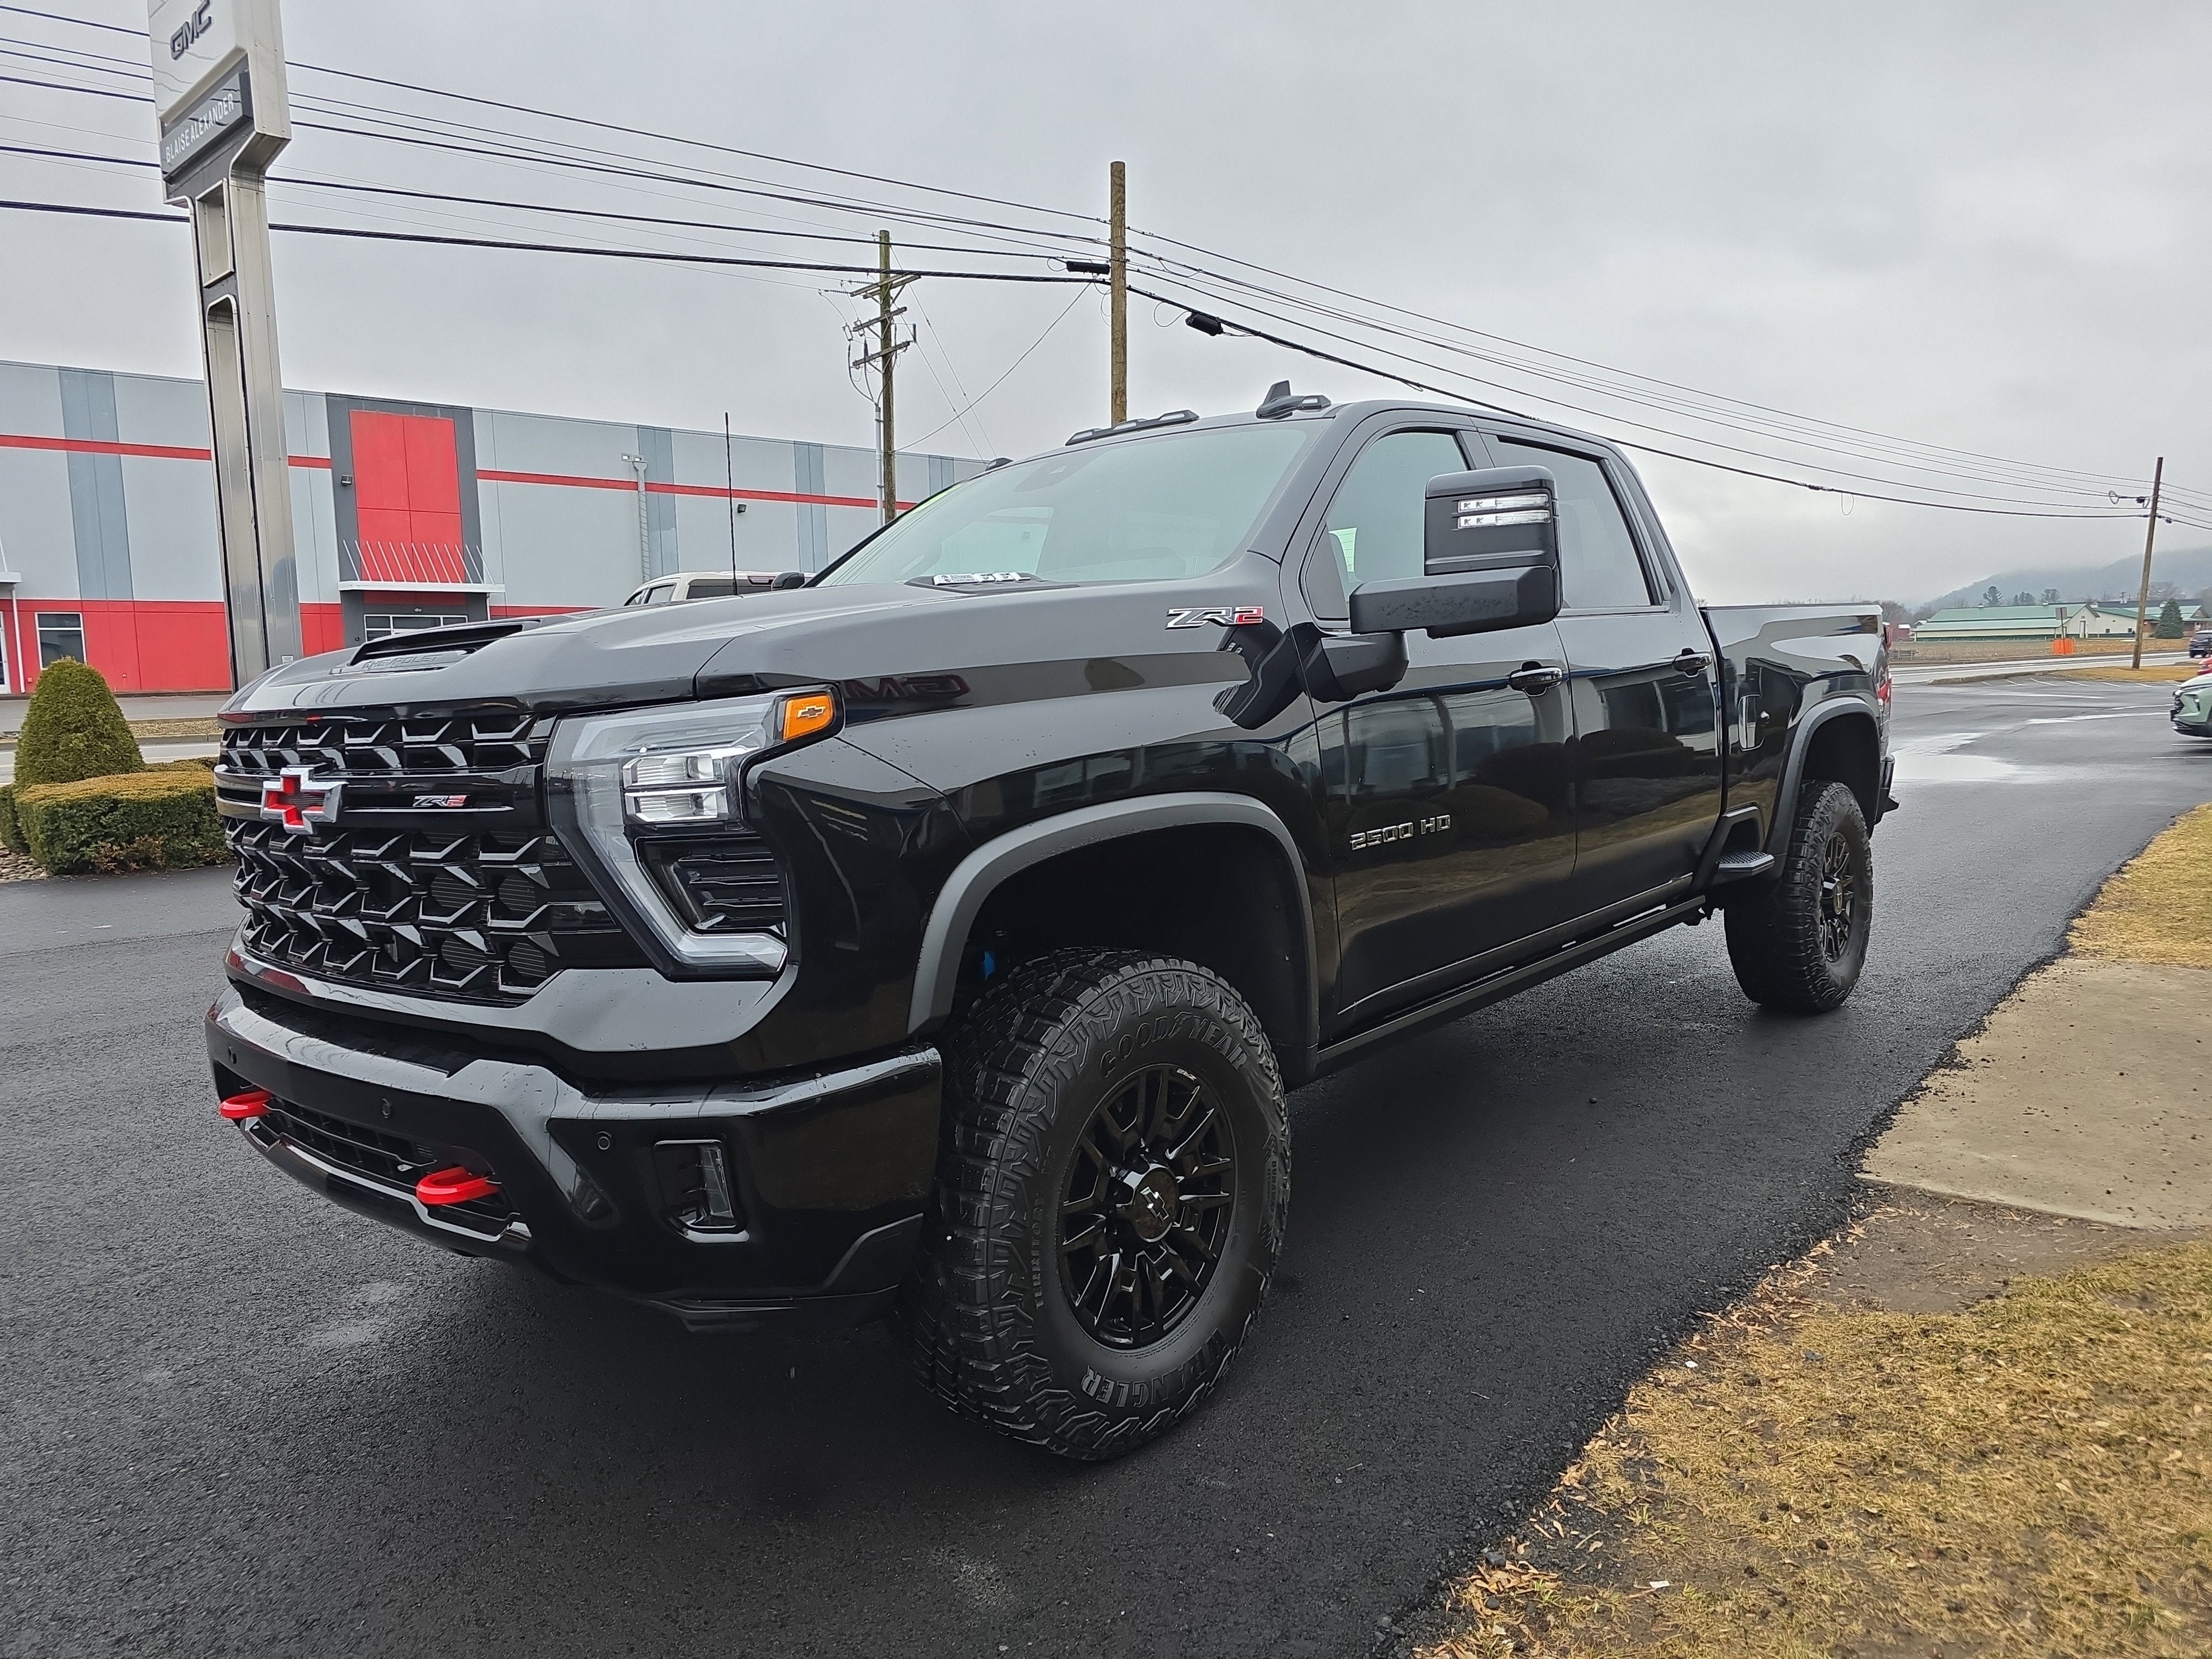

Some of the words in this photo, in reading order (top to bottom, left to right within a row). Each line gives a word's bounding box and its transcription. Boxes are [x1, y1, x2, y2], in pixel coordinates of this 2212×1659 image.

[170, 0, 214, 60] GMC
[165, 128, 190, 163] BLAISE
[191, 93, 234, 145] ALEXANDER
[1165, 606, 1263, 630] ZR2
[362, 654, 443, 668] CHEVROLET
[413, 795, 467, 808] ZR2
[1350, 822, 1413, 851] 2500
[1420, 814, 1451, 834] HD
[1099, 1011, 1248, 1078] GOODYEAR
[1081, 1328, 1230, 1408] WRANGLER
